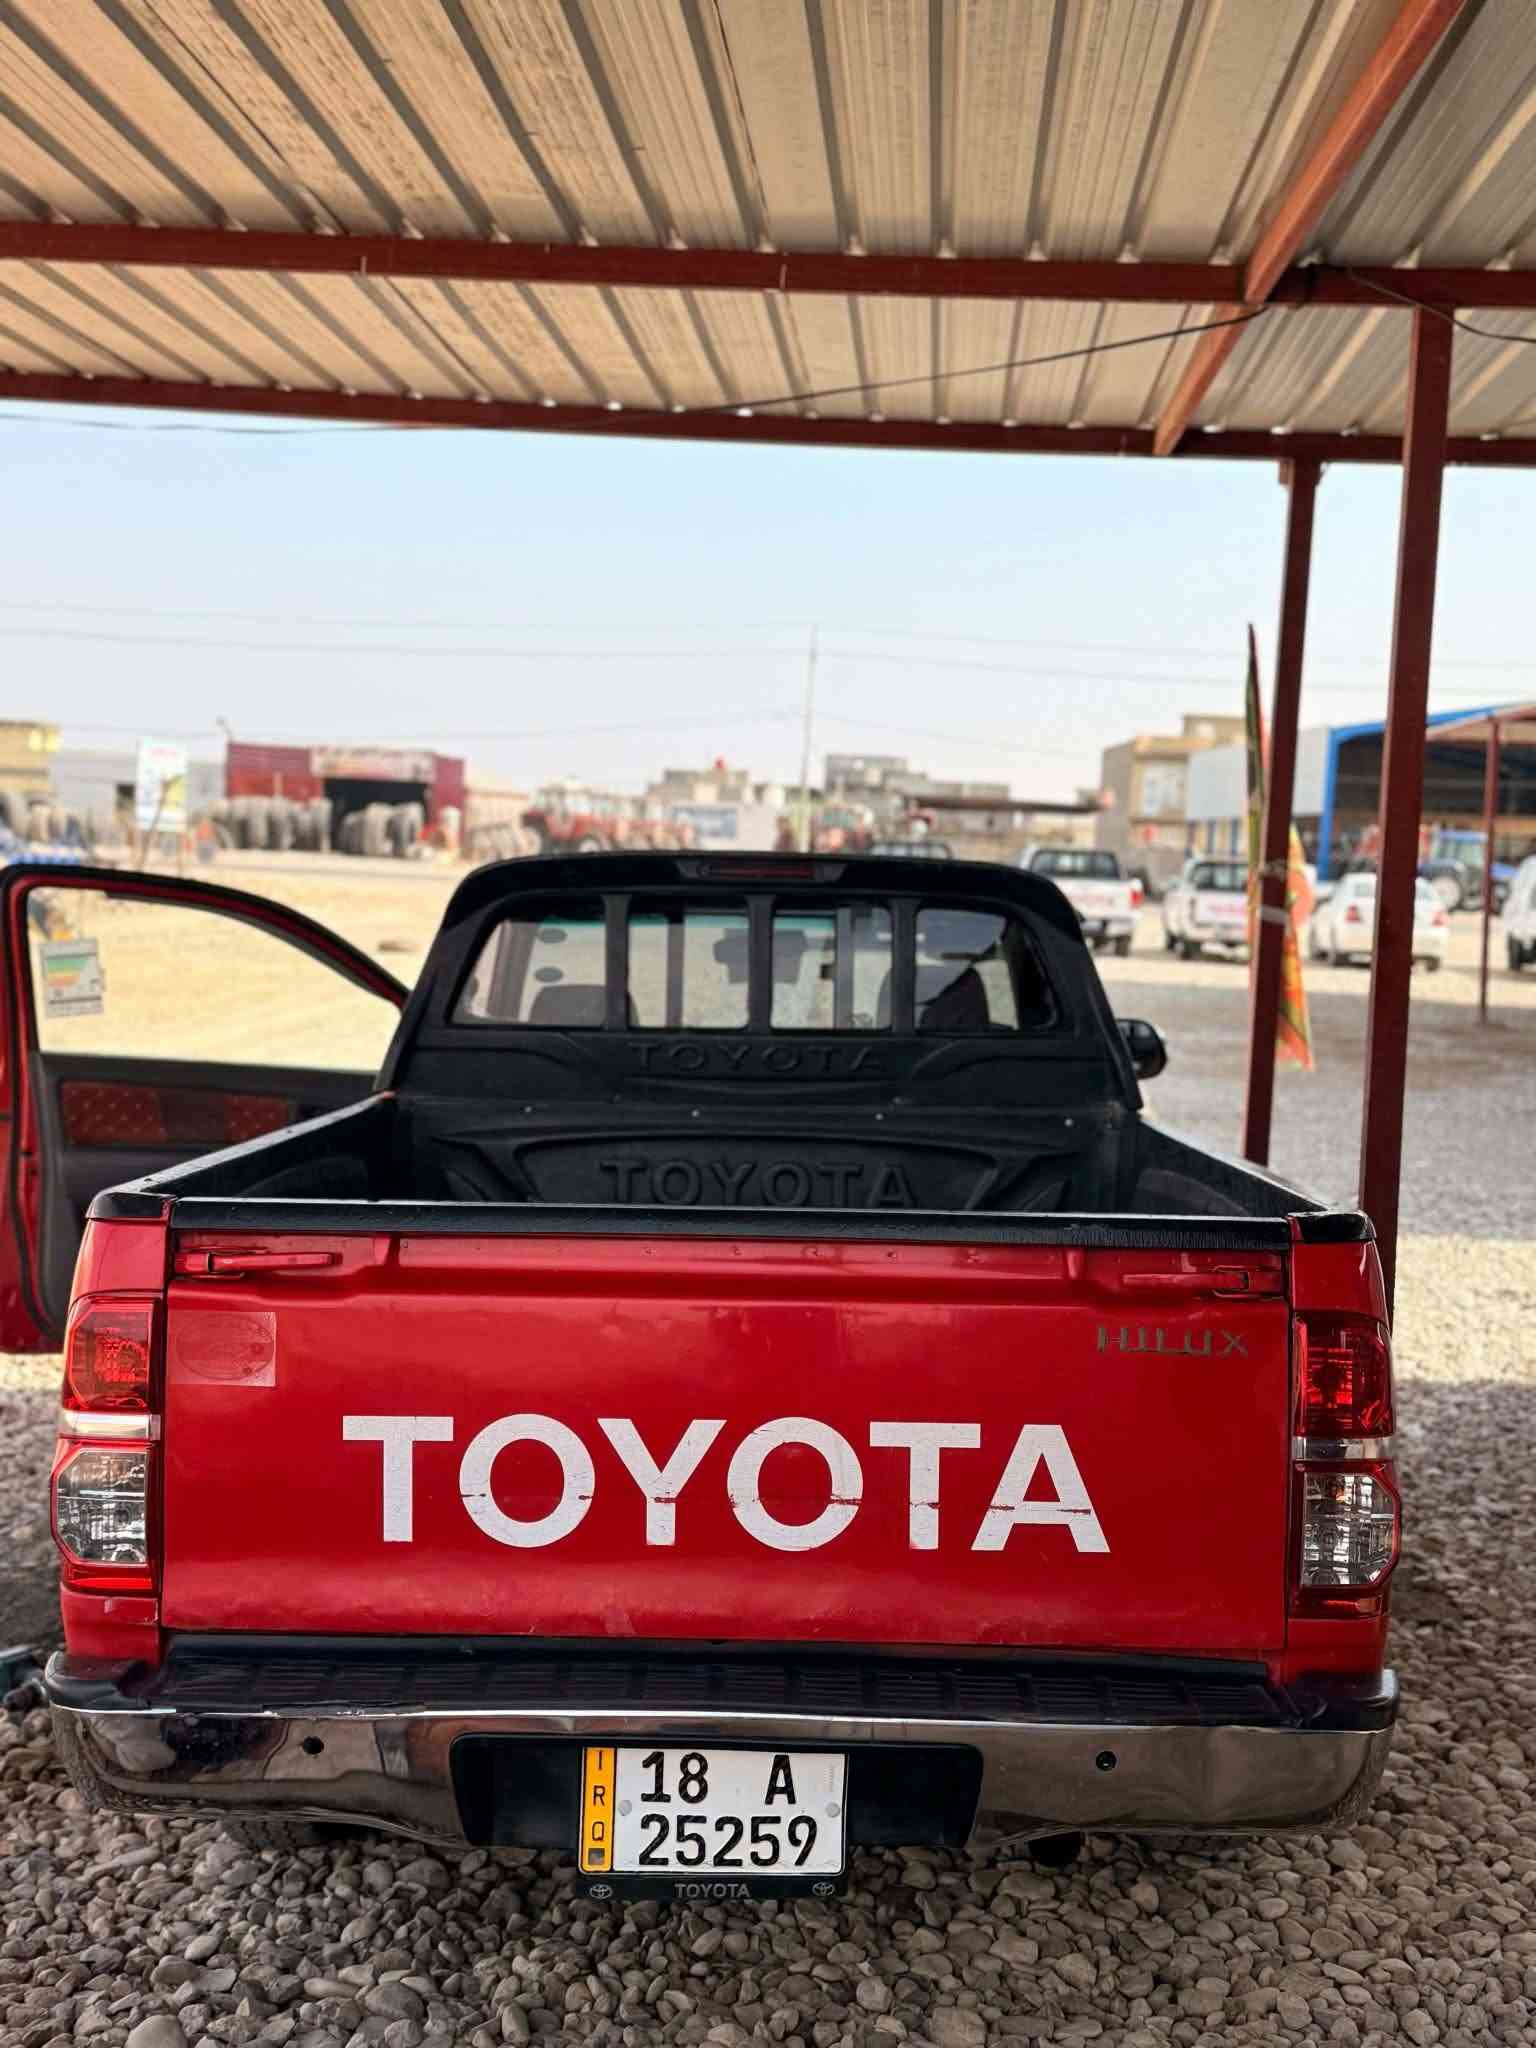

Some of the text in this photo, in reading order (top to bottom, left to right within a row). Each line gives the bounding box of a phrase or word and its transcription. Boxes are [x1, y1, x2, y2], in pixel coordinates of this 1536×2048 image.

[628, 1043, 886, 1073] TOYOTA
[600, 1158, 918, 1208] TOYOTA
[1096, 1325, 1249, 1358] HILUX
[342, 1413, 1111, 1554] TOYOTA
[641, 1751, 710, 1804] 18
[765, 1754, 797, 1805] A
[639, 1813, 819, 1867] 25259
[675, 1883, 752, 1898] TOYOTA
